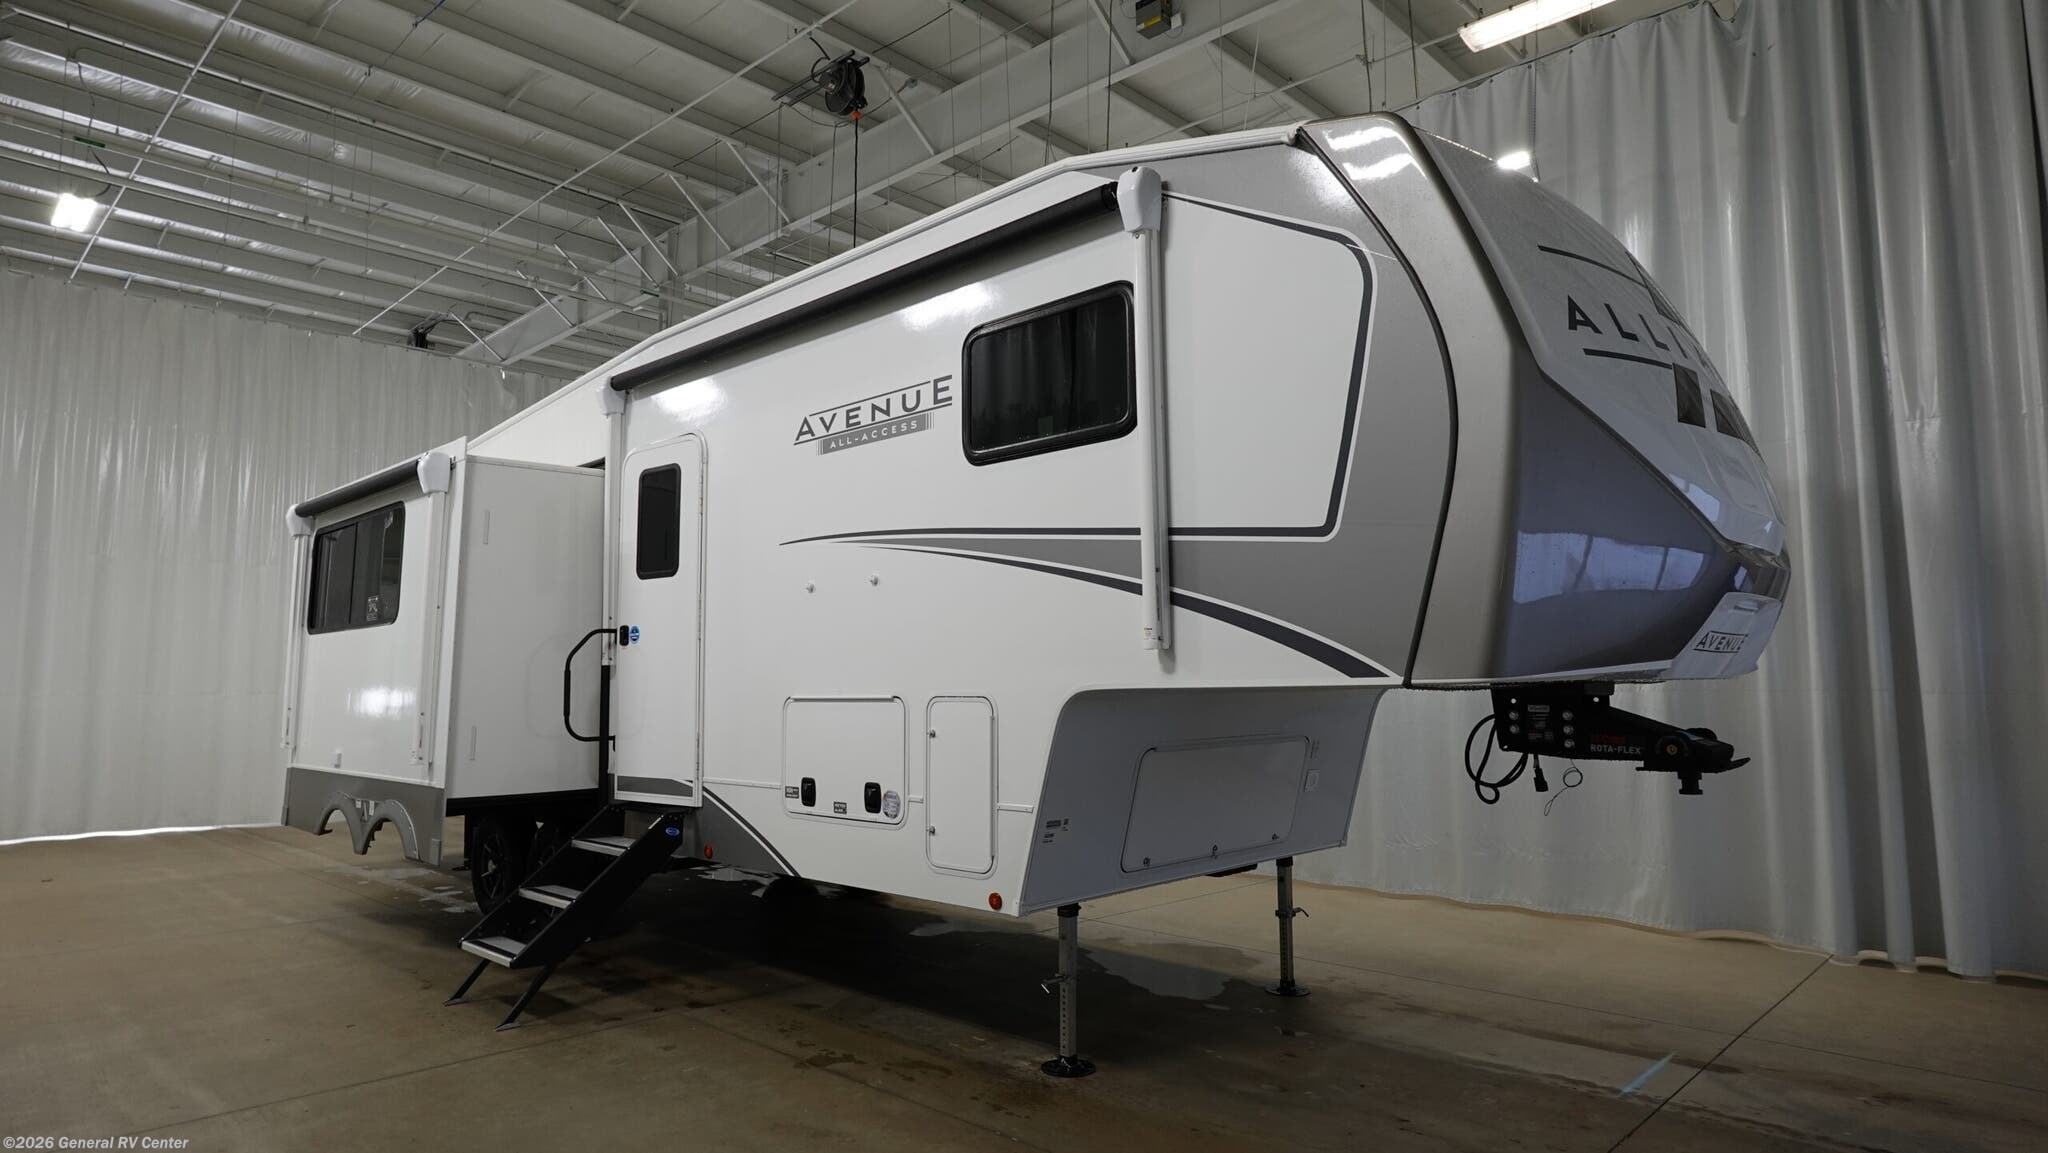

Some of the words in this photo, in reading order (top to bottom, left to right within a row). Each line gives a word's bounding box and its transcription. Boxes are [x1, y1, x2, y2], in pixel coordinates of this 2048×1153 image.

[1567, 295, 1704, 366] ALLI
[795, 374, 953, 442] AVENUE
[829, 420, 918, 449] ALL-ACCESS
[1696, 631, 1748, 651] AVENUE
[1590, 743, 1641, 755] ROTA-FLEX
